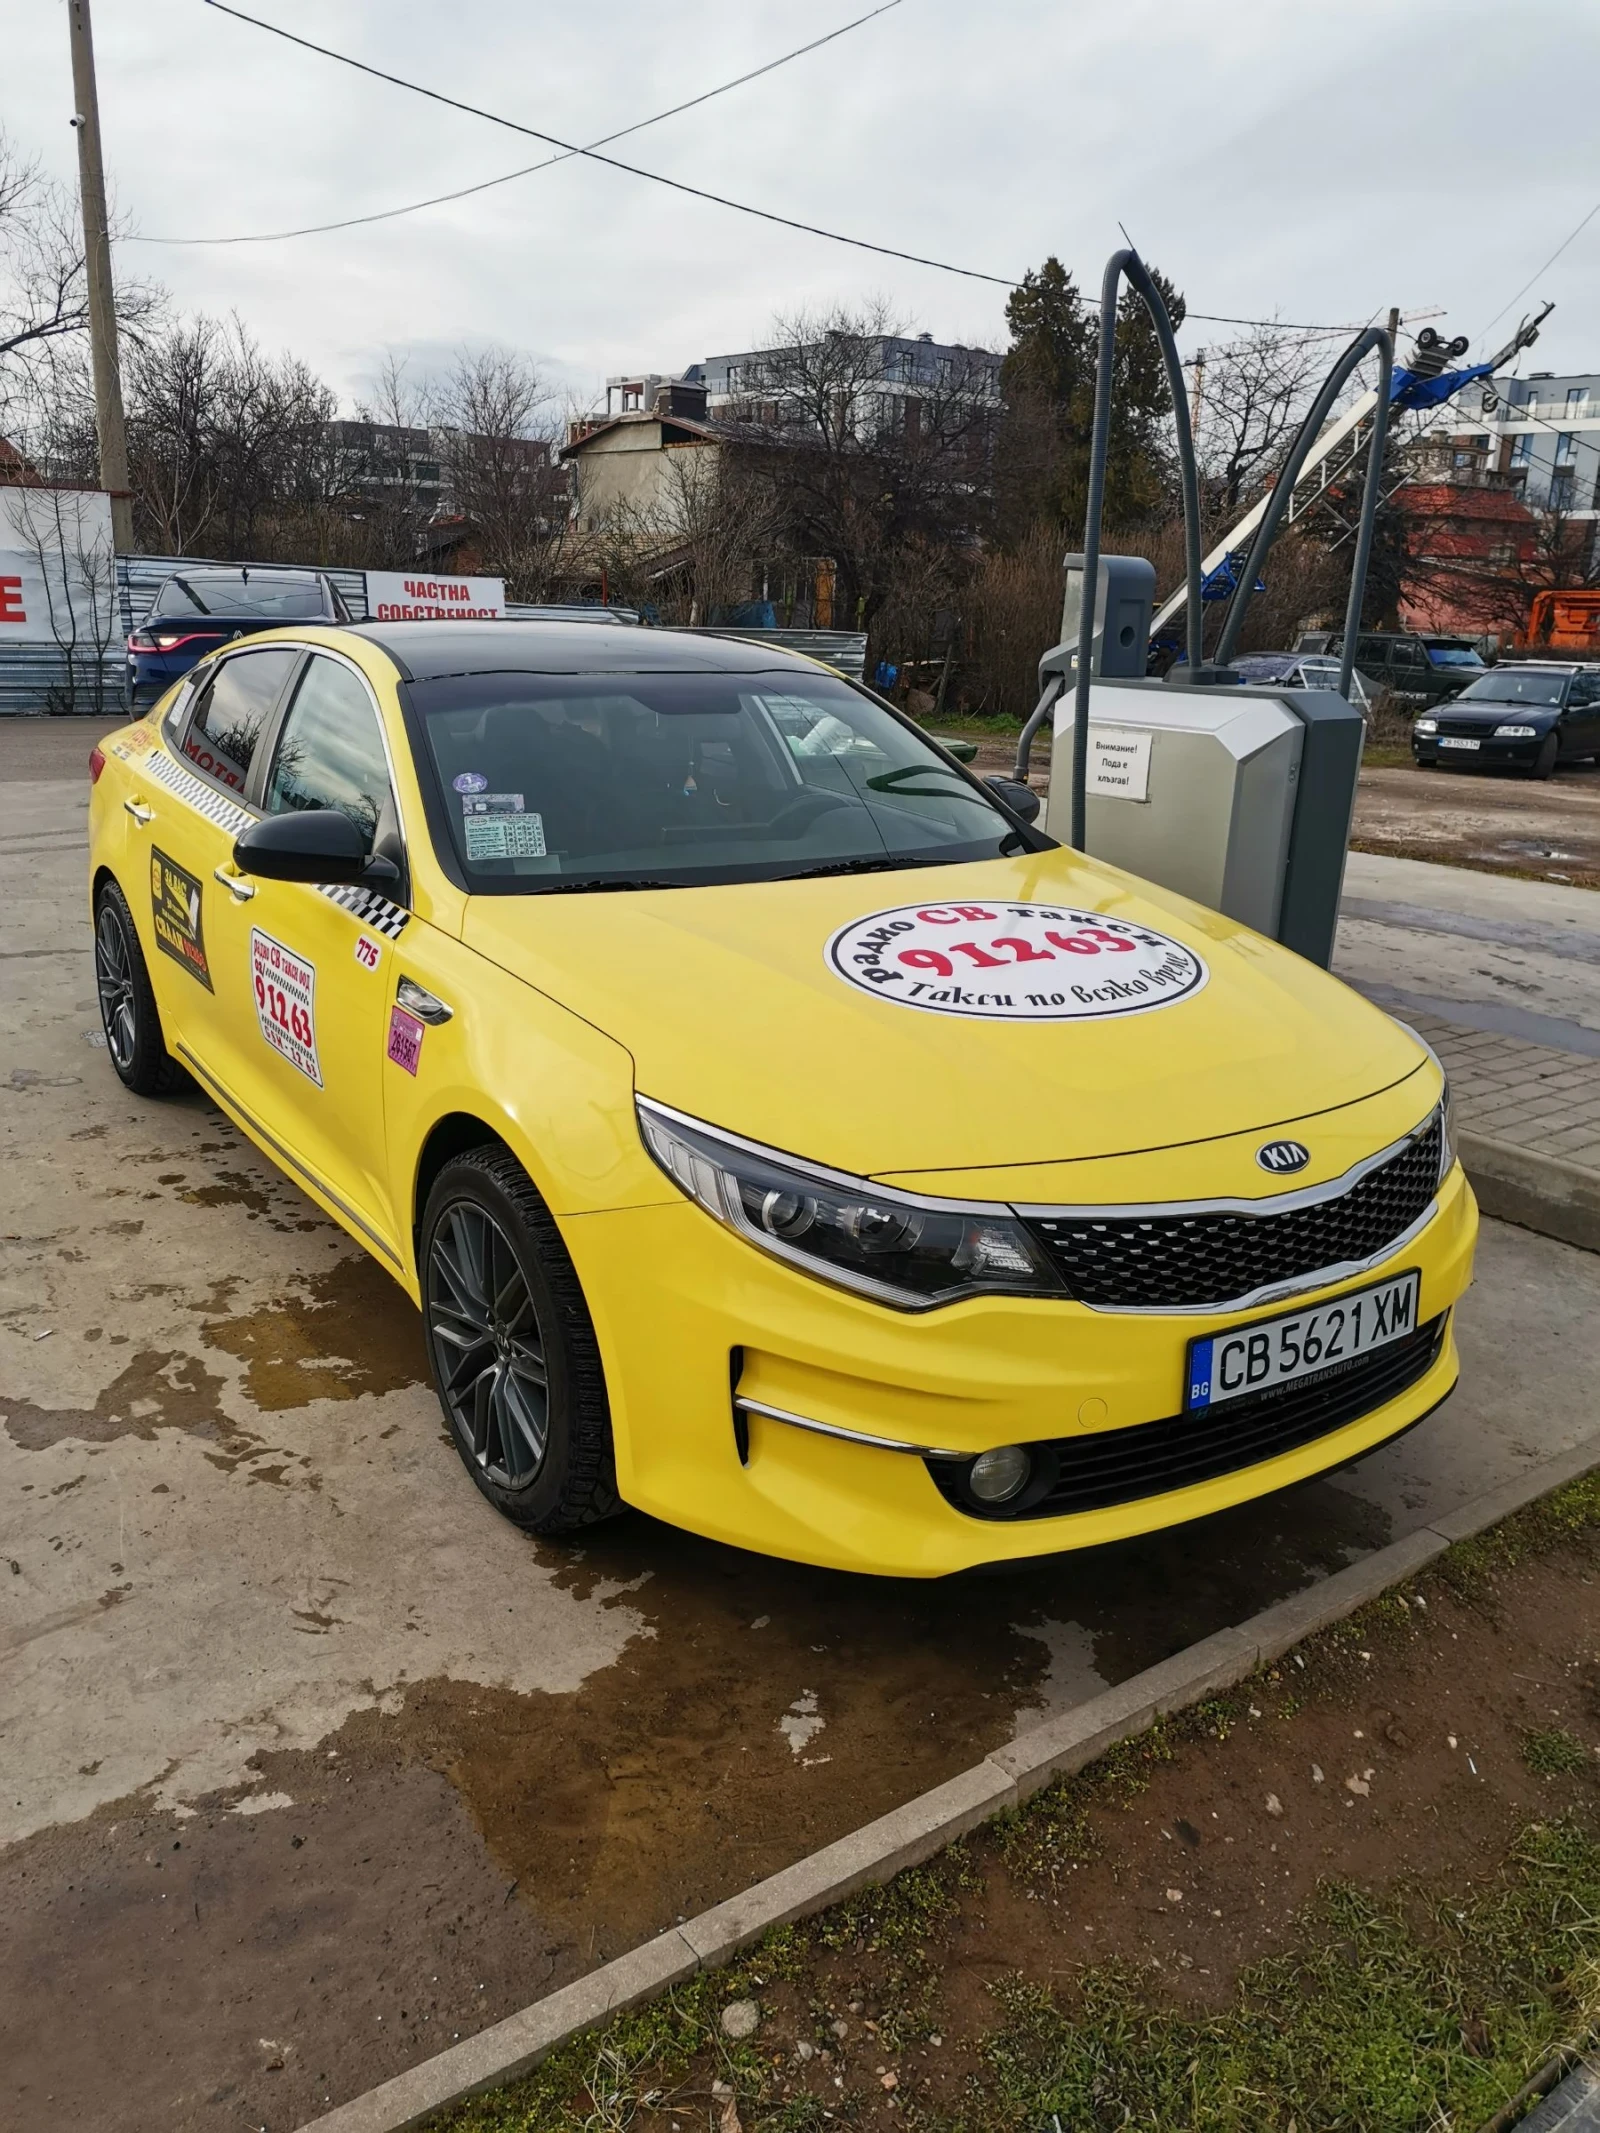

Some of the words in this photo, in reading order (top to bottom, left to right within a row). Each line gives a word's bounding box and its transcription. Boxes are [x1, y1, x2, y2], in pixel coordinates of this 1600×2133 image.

[404, 581, 471, 601] ЧАСТНА
[378, 604, 498, 620] СОБСТВЕНОСТ
[1096, 741, 1138, 754] Внимание!
[1101, 758, 1121, 769] Пода
[1122, 761, 1128, 769] е
[1097, 774, 1130, 785] хлъзгав!
[357, 937, 378, 966] 775
[853, 920, 916, 984] радио
[916, 906, 998, 925] СВ
[1006, 907, 1169, 948] такси
[898, 928, 1137, 977] 91263
[271, 946, 281, 969] СВ
[907, 982, 1017, 1007] Такси
[1025, 992, 1066, 1007] по
[1070, 979, 1148, 1005] всяко
[1263, 1143, 1307, 1168] KIA
[1219, 1333, 1270, 1391] CB
[1279, 1301, 1362, 1373] 5621
[1371, 1281, 1412, 1342] XM
[1260, 1355, 1371, 1401] www.MEGATRANSAUTO.com
[1191, 1381, 1210, 1400] BG
